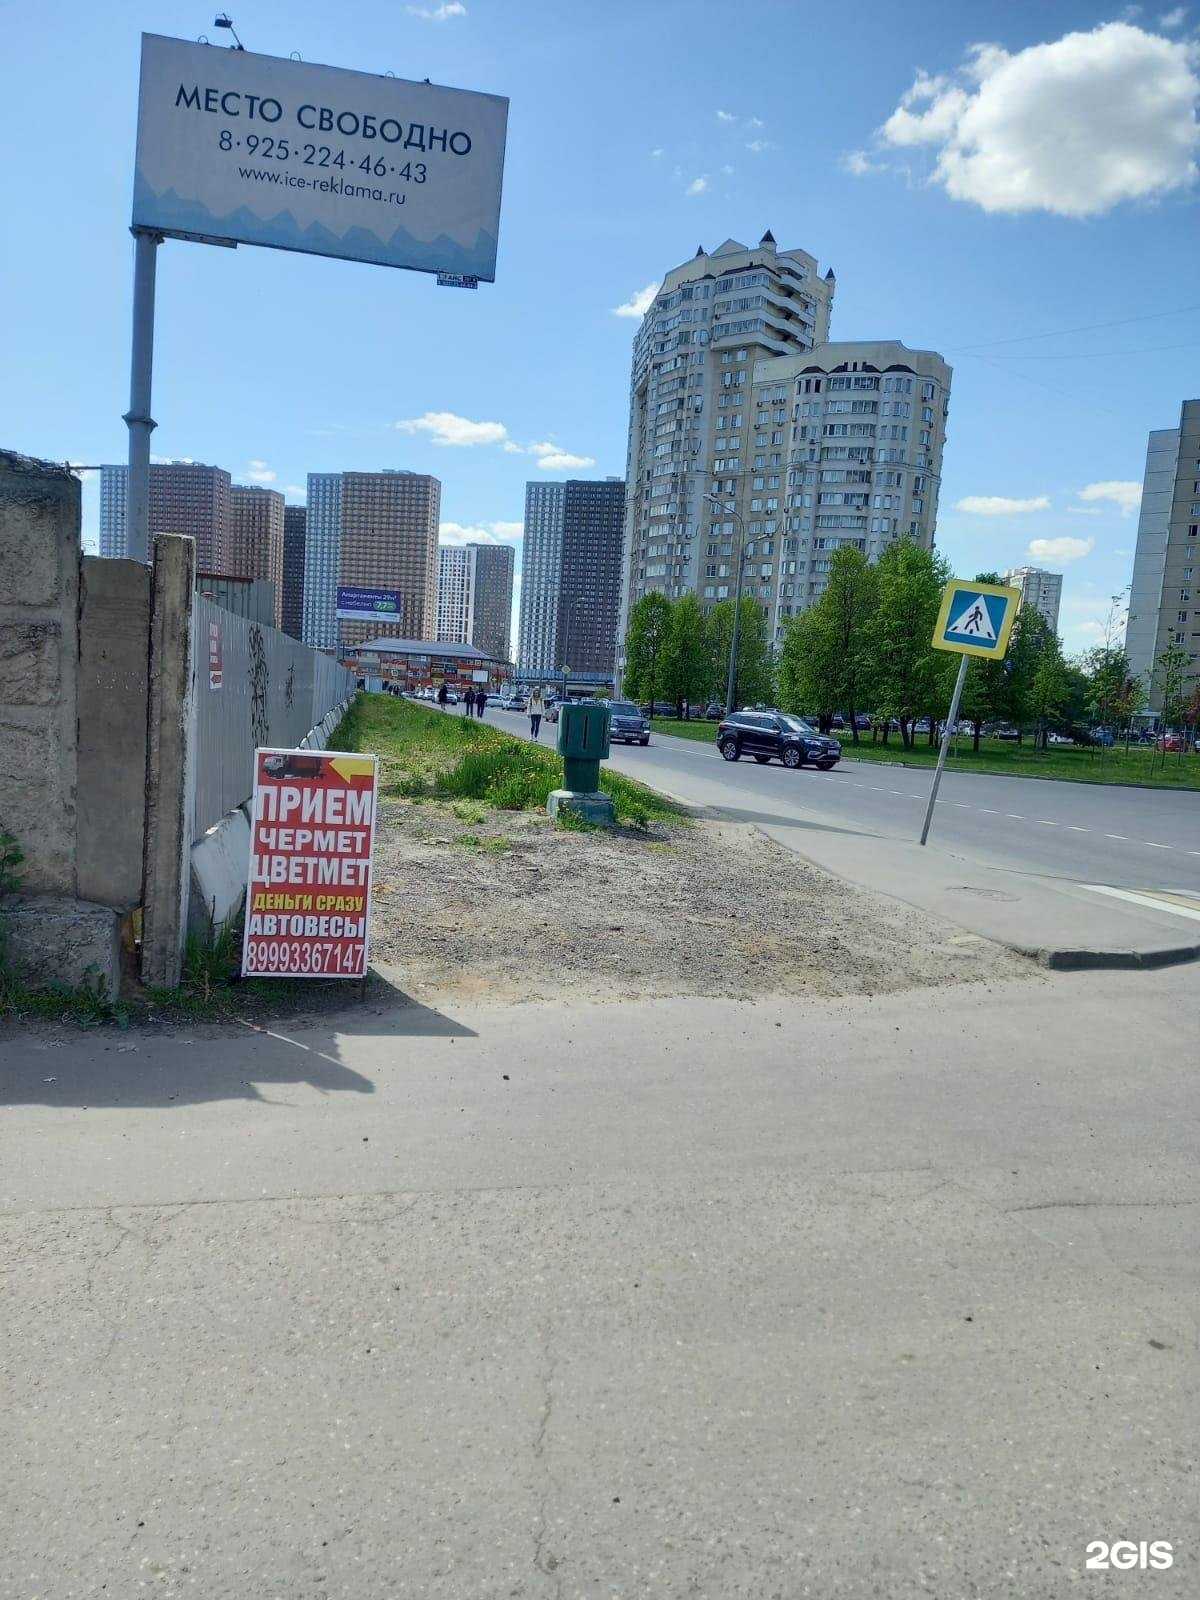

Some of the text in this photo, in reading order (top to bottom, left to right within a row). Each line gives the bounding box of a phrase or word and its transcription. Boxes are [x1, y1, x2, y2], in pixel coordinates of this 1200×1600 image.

[175, 83, 473, 156] МЕСТО СВОБОДНО
[238, 165, 406, 206] www.ice-reklama.ru
[255, 785, 372, 826] ПРИЕМ
[259, 827, 366, 853] ЧЕРМЕТ
[252, 854, 370, 888] ЦВЕТМЕТ
[253, 893, 364, 913] ДЕНЬГИ СРАЗУ
[250, 914, 366, 939] АВТОВЕСЫ
[247, 941, 365, 973] 89993367147
